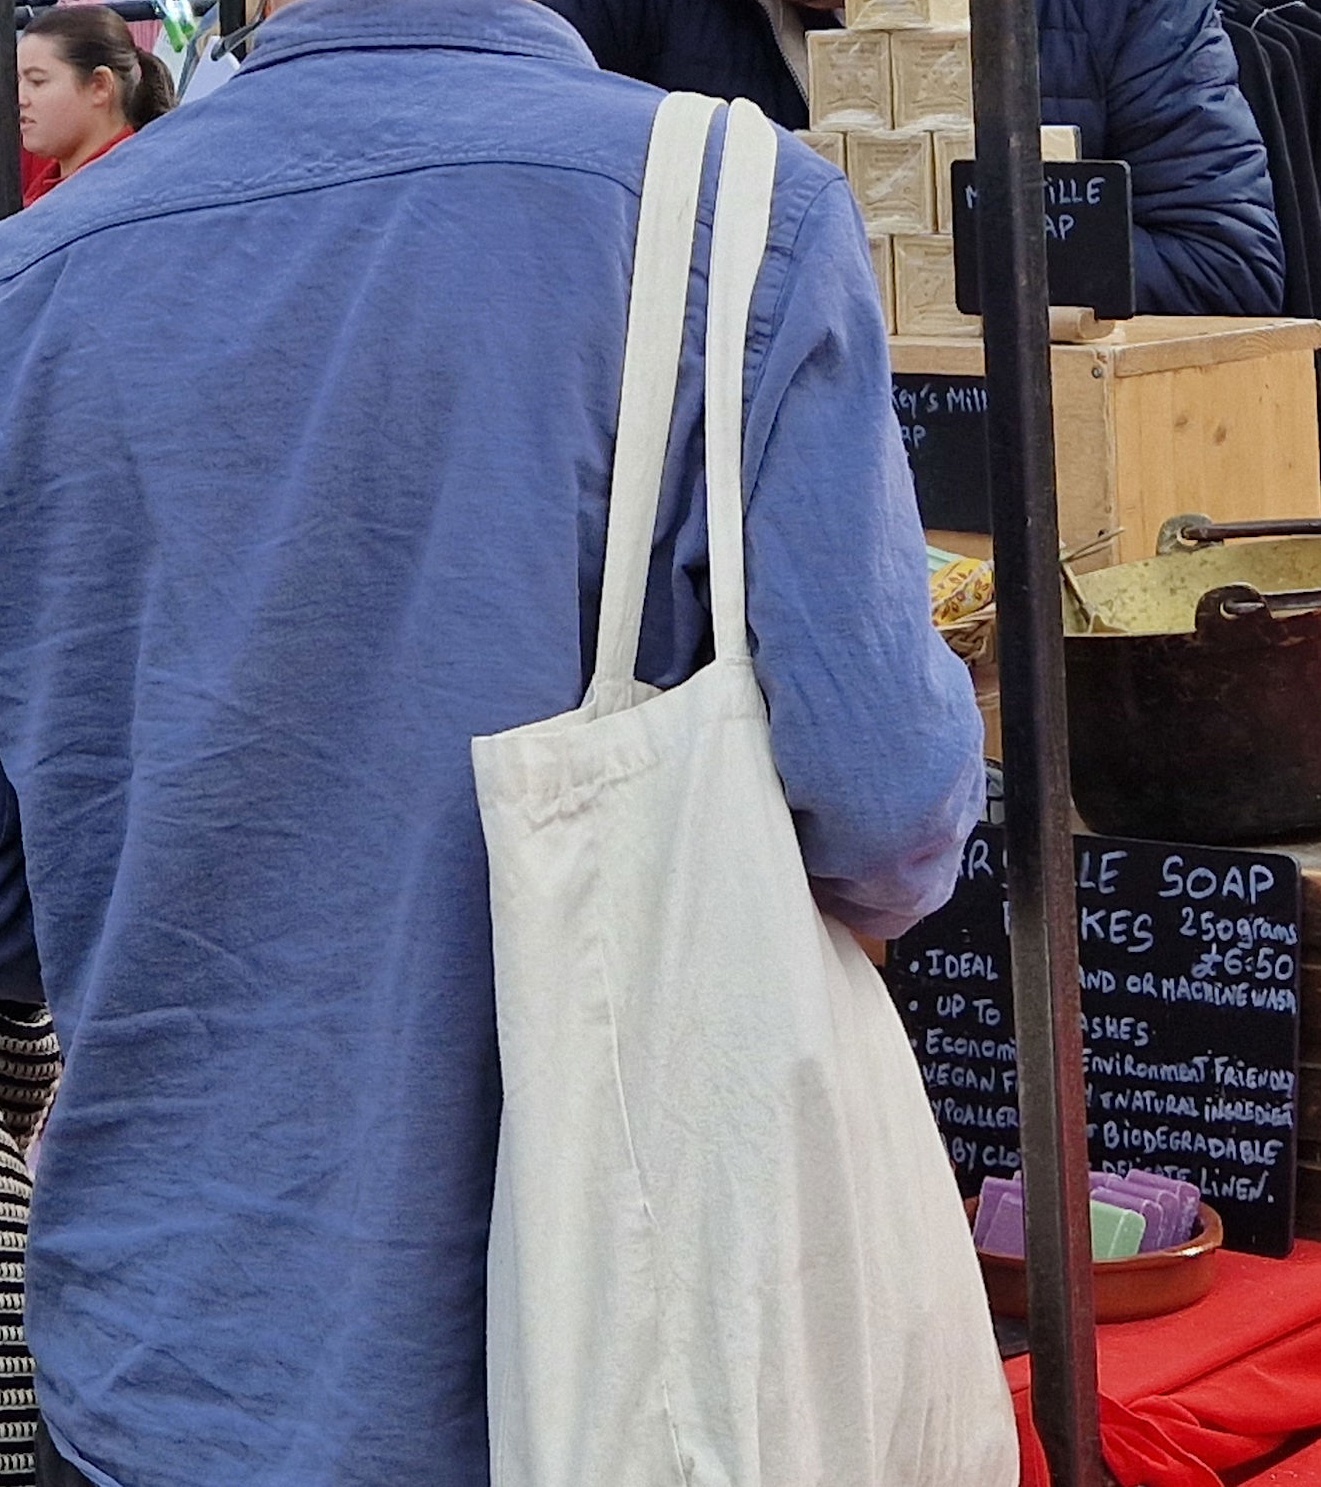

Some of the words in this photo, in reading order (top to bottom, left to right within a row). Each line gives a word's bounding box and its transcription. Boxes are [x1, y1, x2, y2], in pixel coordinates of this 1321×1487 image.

[1158, 855, 1274, 905] SOAP
[926, 949, 998, 981] IDEAL
[1078, 965, 1116, 993] AND
[1127, 972, 1158, 998] OR
[937, 993, 965, 1018] UP
[973, 998, 1001, 1026] TO
[1079, 1012, 1149, 1047] ASHES
[922, 1062, 995, 1092] VEGAN
